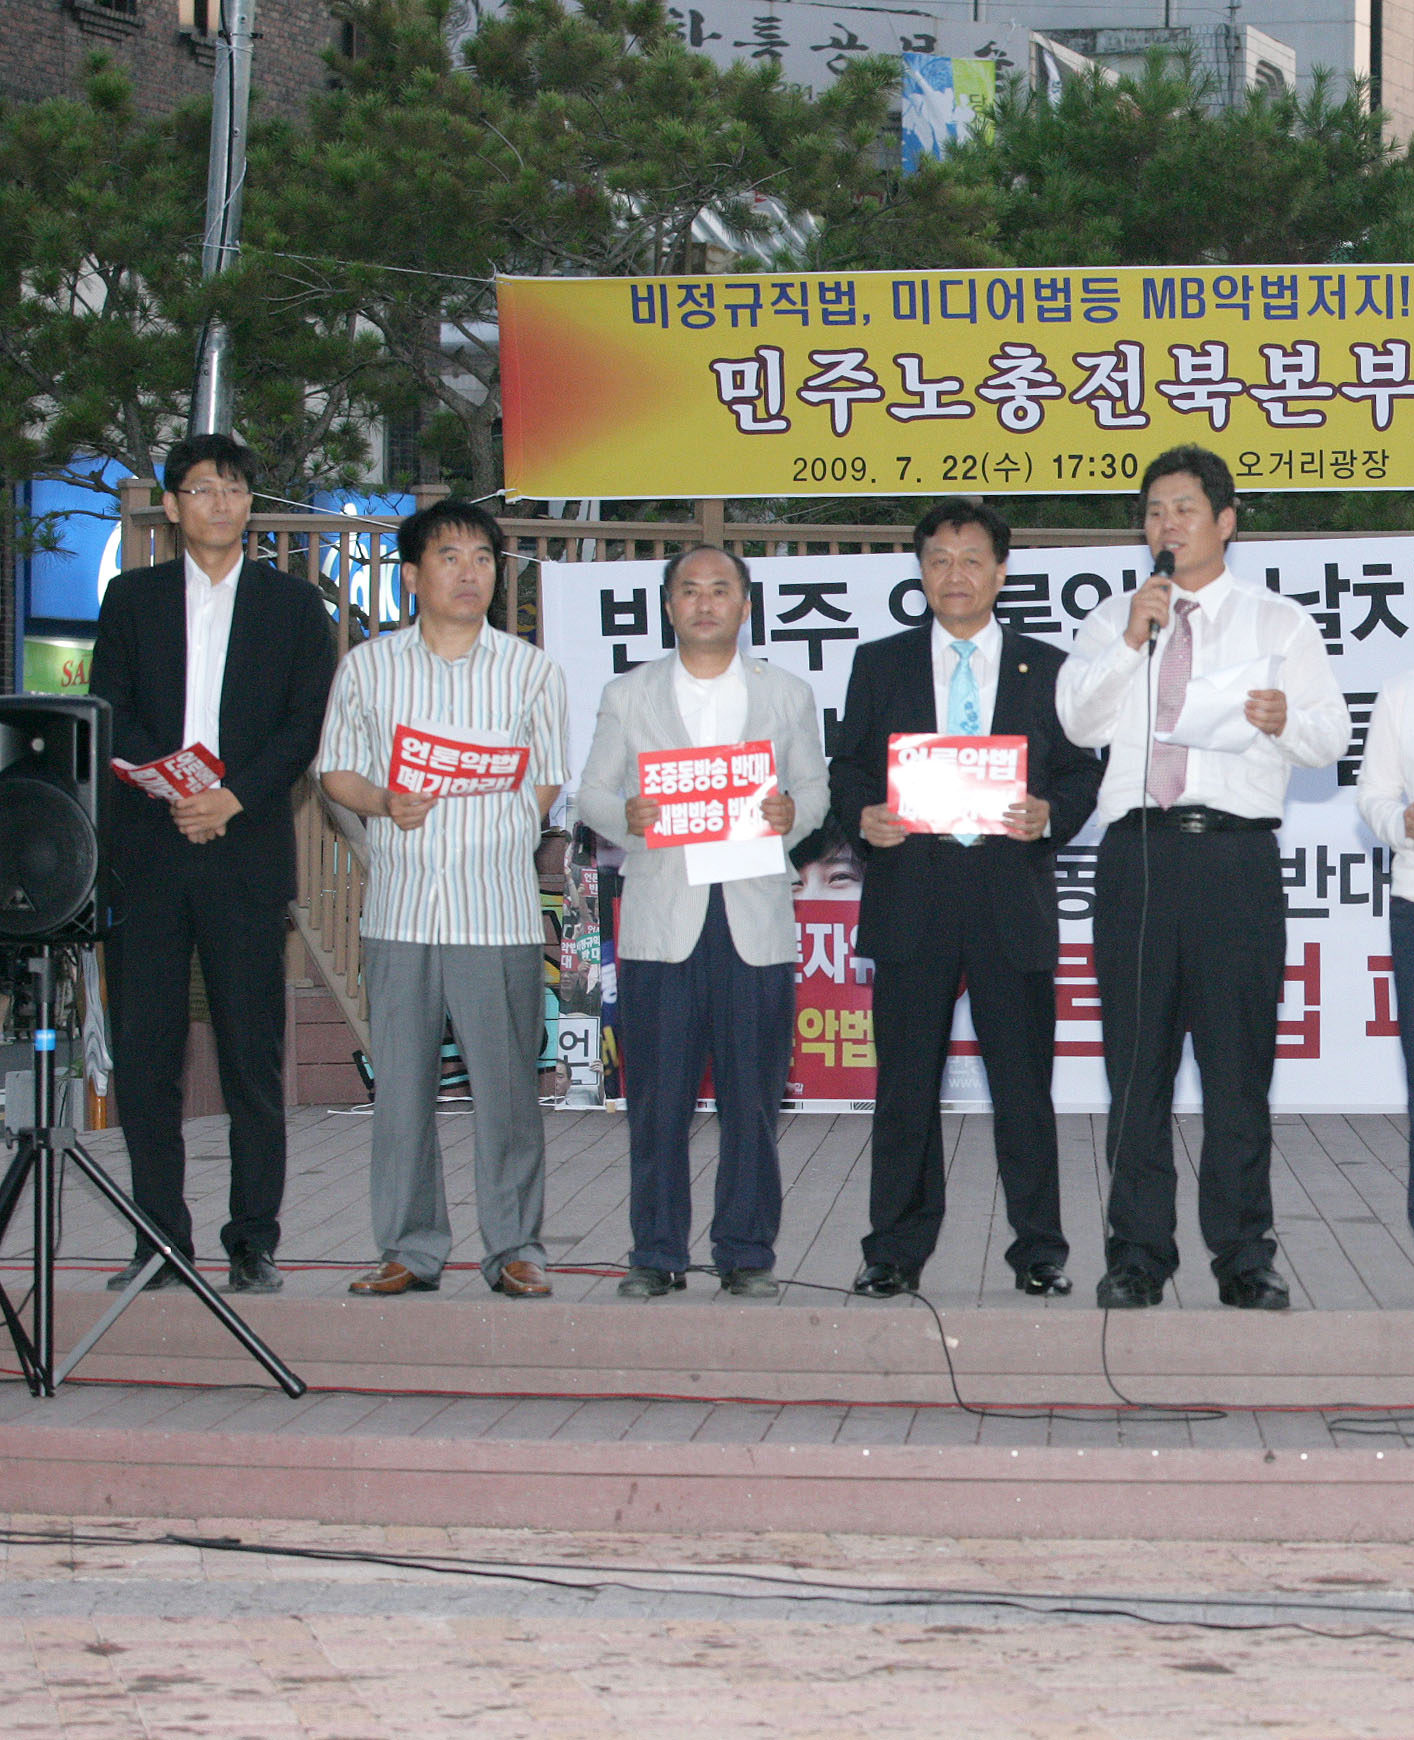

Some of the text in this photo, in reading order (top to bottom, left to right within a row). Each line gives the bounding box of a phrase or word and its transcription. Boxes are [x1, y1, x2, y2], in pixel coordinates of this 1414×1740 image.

[630, 283, 873, 330] 비정규직법,
[892, 278, 1121, 326] 미디어법등
[1143, 274, 1410, 321] MB악법저지!
[793, 451, 1139, 483] 2009. 7. 22(수) 17:30
[1236, 448, 1389, 480] 오거리광장
[401, 737, 521, 774] 언론악법
[644, 753, 770, 795] 조중동방송 반대!
